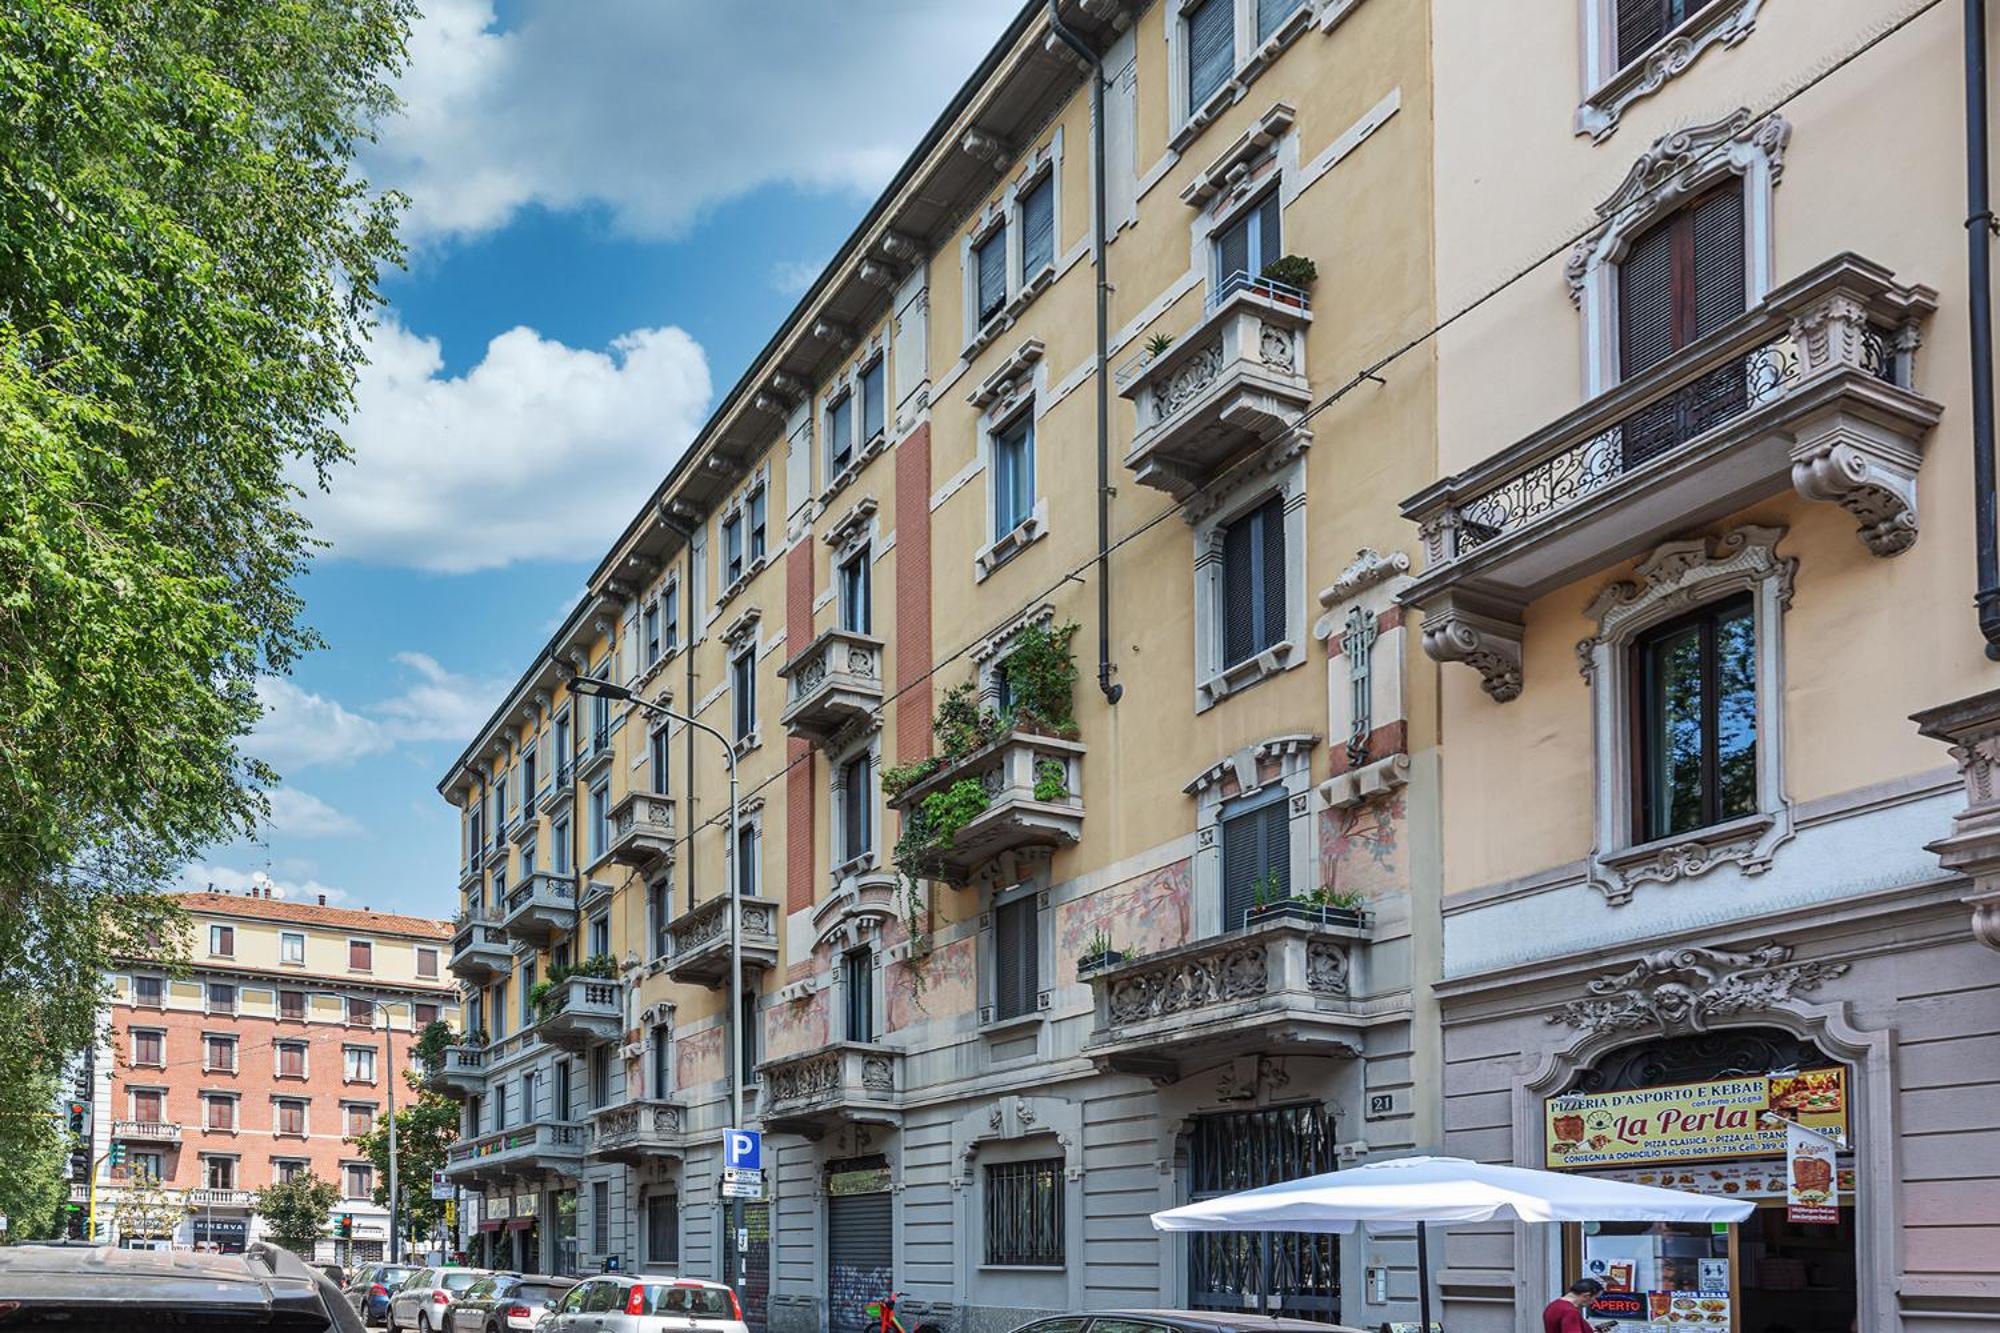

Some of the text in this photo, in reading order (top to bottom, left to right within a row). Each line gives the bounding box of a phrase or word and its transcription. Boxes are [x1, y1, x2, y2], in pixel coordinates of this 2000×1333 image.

[1374, 1097, 1390, 1110] 21
[1551, 1081, 1763, 1112] PIZZERIA D'ASPORTO E KEBAB
[1613, 1105, 1749, 1145] La Perla
[1644, 1138, 1668, 1148] PIZZA
[1669, 1136, 1708, 1147] CLASSICA
[1715, 1132, 1741, 1143] PIZZA
[731, 1134, 753, 1163] P
[1564, 1152, 1606, 1163] CONSEGNA
[1616, 1149, 1661, 1159] DOMICILIO
[196, 1223, 243, 1231] MINERVA
[1591, 1299, 1641, 1312] APERTO
